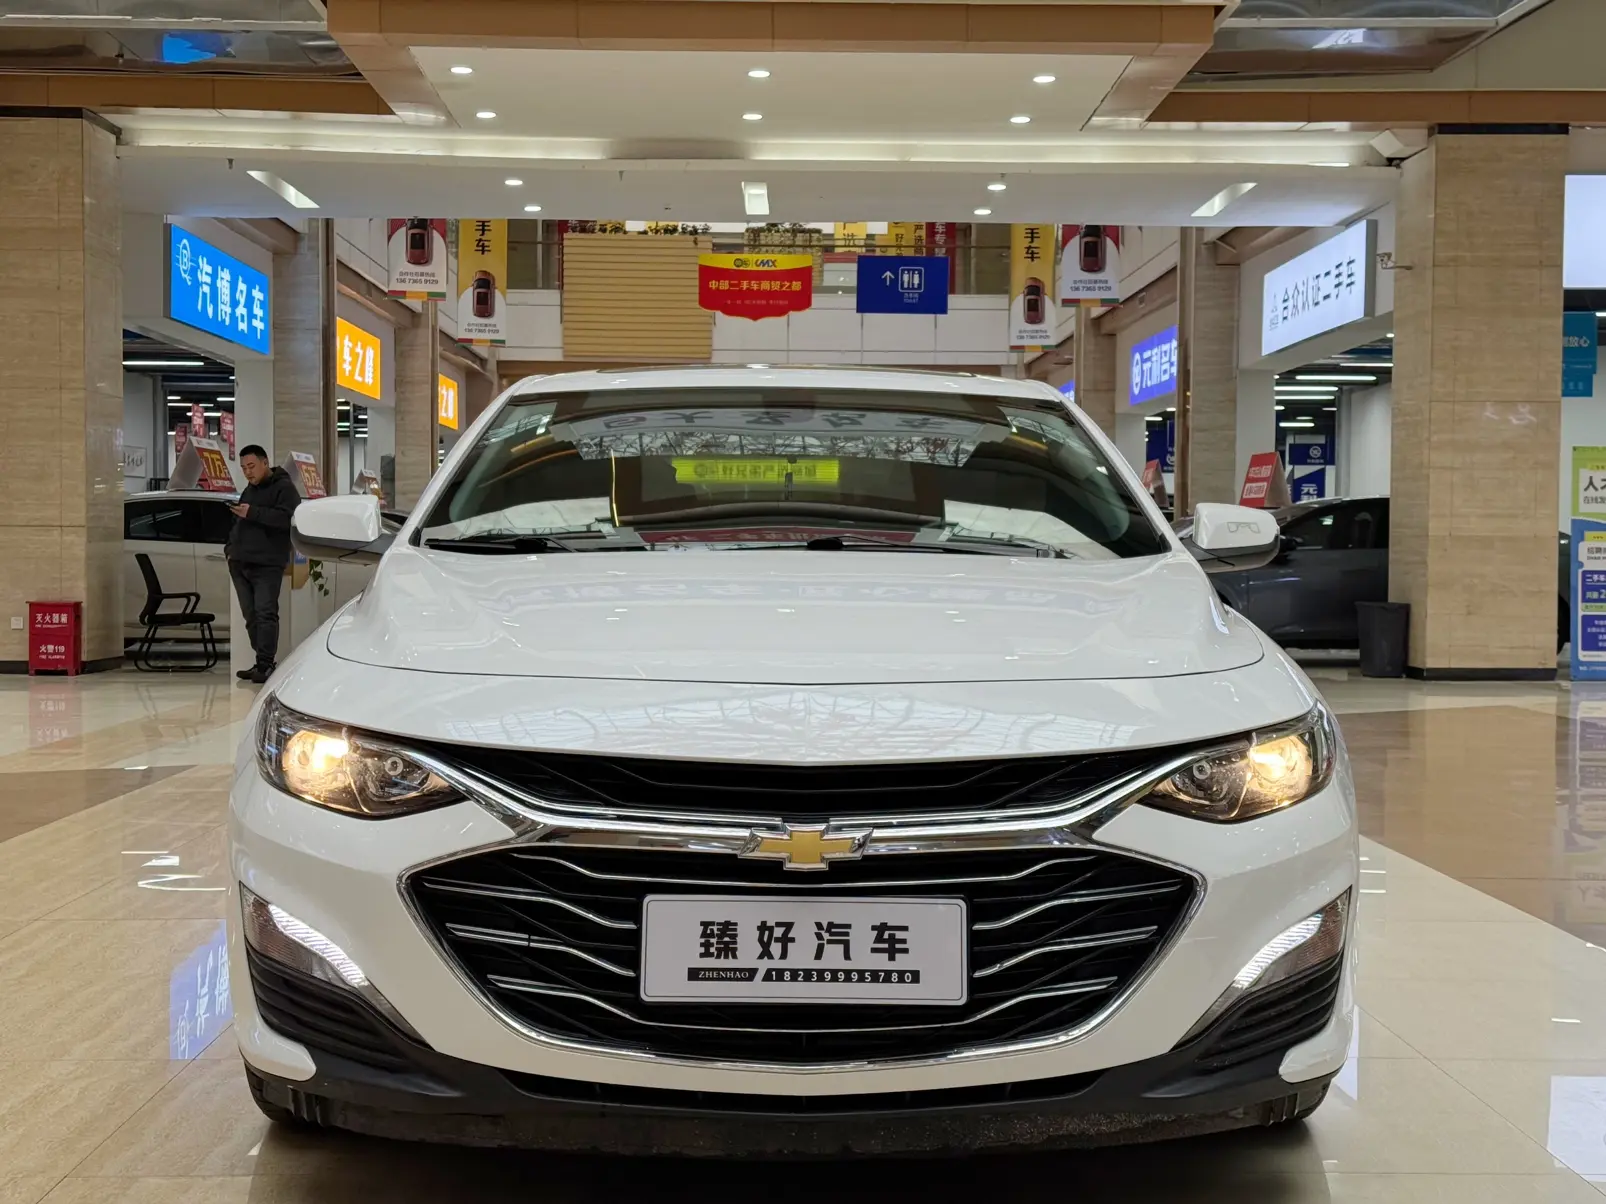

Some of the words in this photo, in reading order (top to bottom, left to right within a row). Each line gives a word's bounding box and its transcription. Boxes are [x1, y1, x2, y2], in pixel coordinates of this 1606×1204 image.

[709, 279, 802, 292] 中部二手车商贸之都
[197, 254, 265, 340] 汽博名车
[1563, 335, 1590, 348] 放心
[36, 612, 68, 623] 灭火器箱
[39, 644, 65, 653] 火警119
[698, 919, 910, 962] 臻好汽车
[697, 970, 750, 979] ZHENHAO
[771, 970, 913, 983] 18239995780
